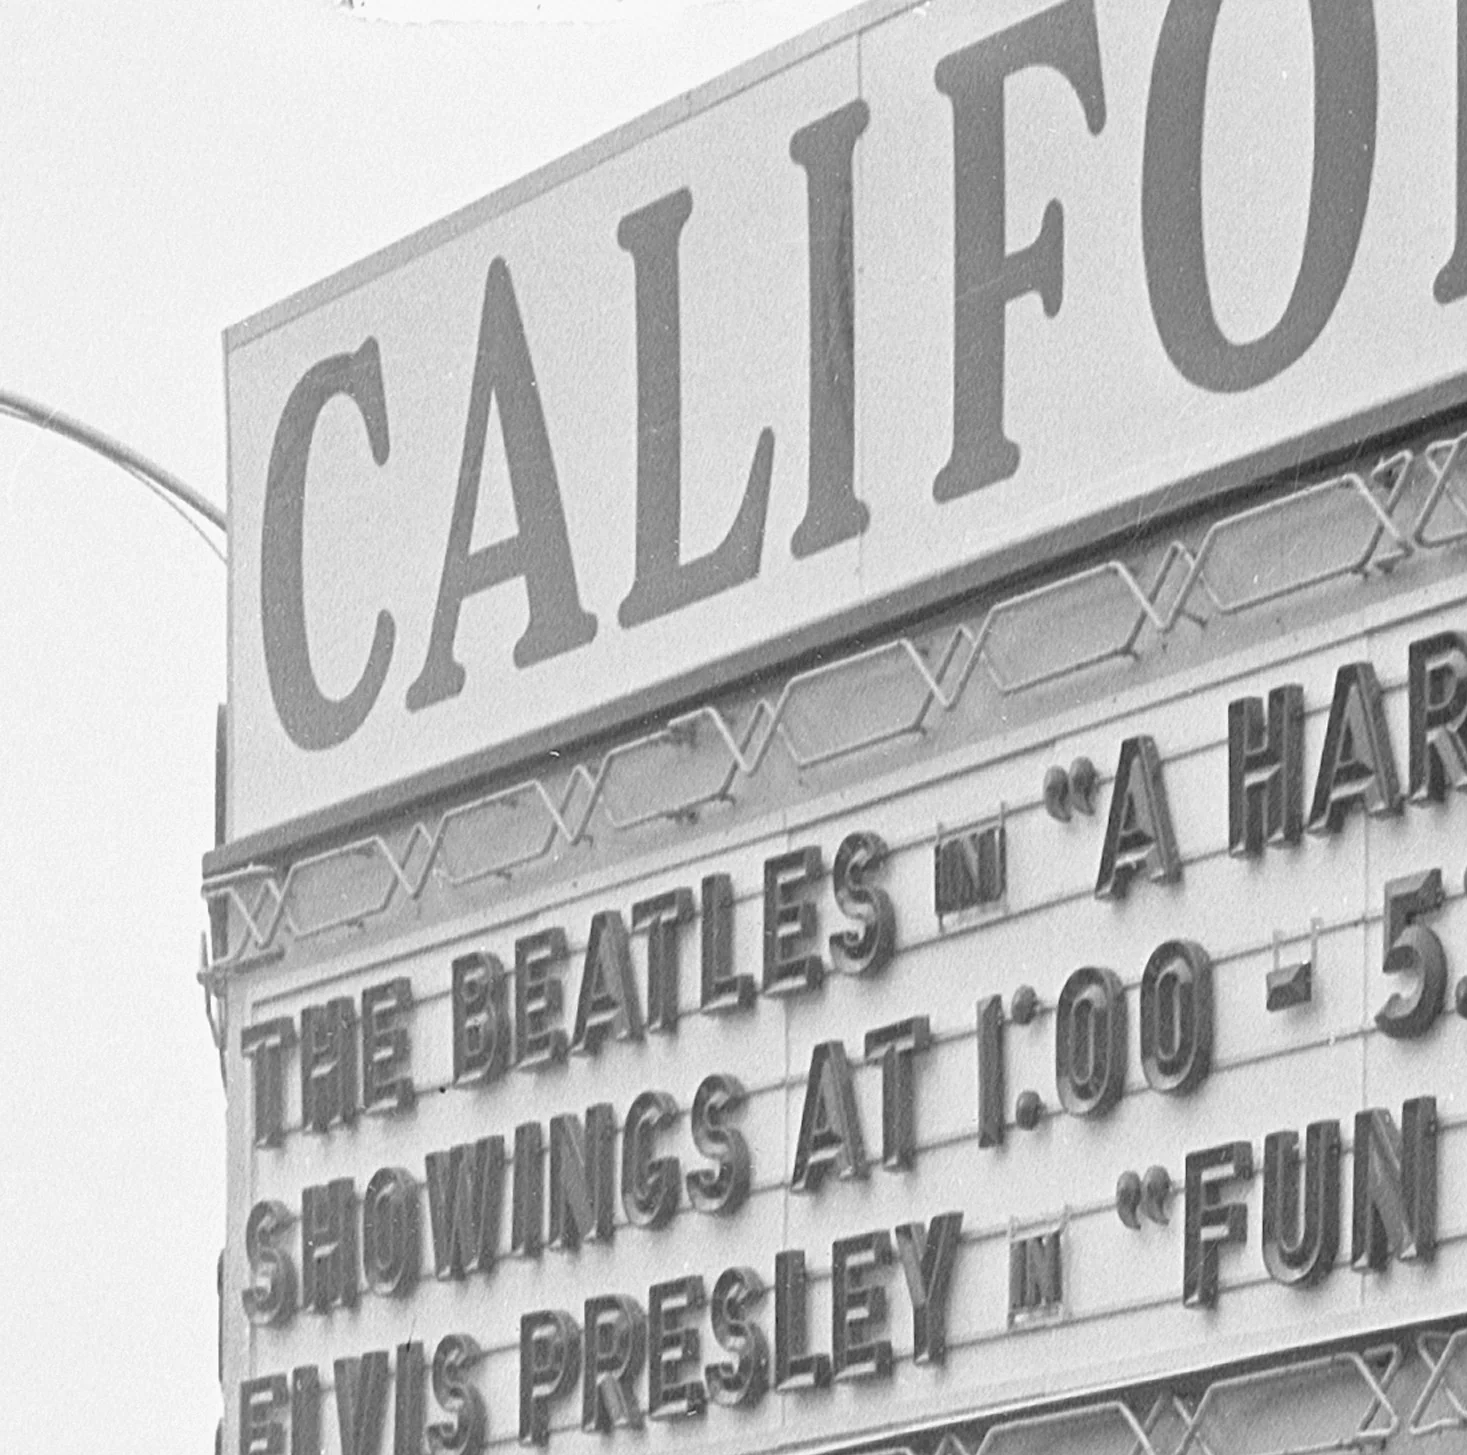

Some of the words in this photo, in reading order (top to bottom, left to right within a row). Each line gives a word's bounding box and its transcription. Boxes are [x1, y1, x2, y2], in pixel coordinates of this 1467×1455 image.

[241, 976, 413, 1150] THE
[452, 828, 897, 1088] BEATLES
[241, 1073, 751, 1327] SHOWINGS
[791, 1015, 931, 1193] AT
[977, 937, 1214, 1150] 1:00
[519, 1210, 965, 1447] PRESLEY
